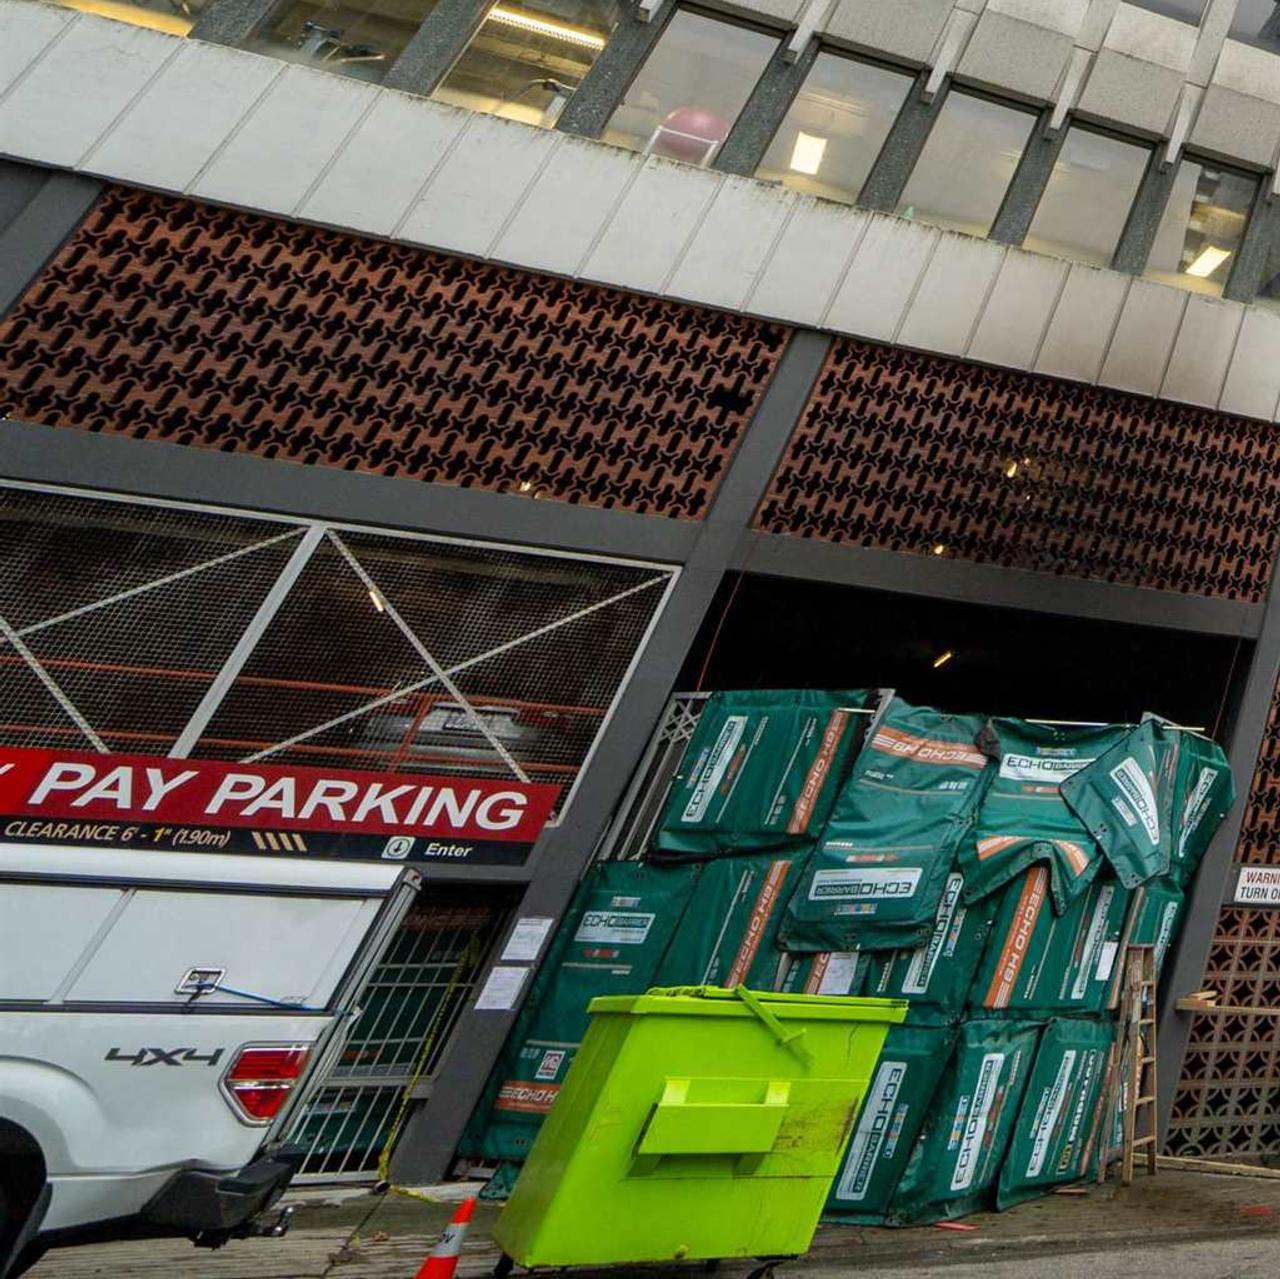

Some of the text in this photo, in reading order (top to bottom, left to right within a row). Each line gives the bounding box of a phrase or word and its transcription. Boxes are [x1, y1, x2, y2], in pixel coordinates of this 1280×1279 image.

[1007, 756, 1053, 770] ECHO
[27, 762, 528, 830] PAY PARKING
[4, 821, 120, 840] CLEARANCE
[424, 842, 473, 858] Enter
[860, 882, 912, 895] ECHO
[1240, 886, 1268, 899] TURN
[1013, 892, 1039, 951] ECHO
[733, 915, 761, 973] ECHO
[853, 1068, 902, 1191] ECHO BARRIER
[955, 1118, 977, 1182] ECHO
